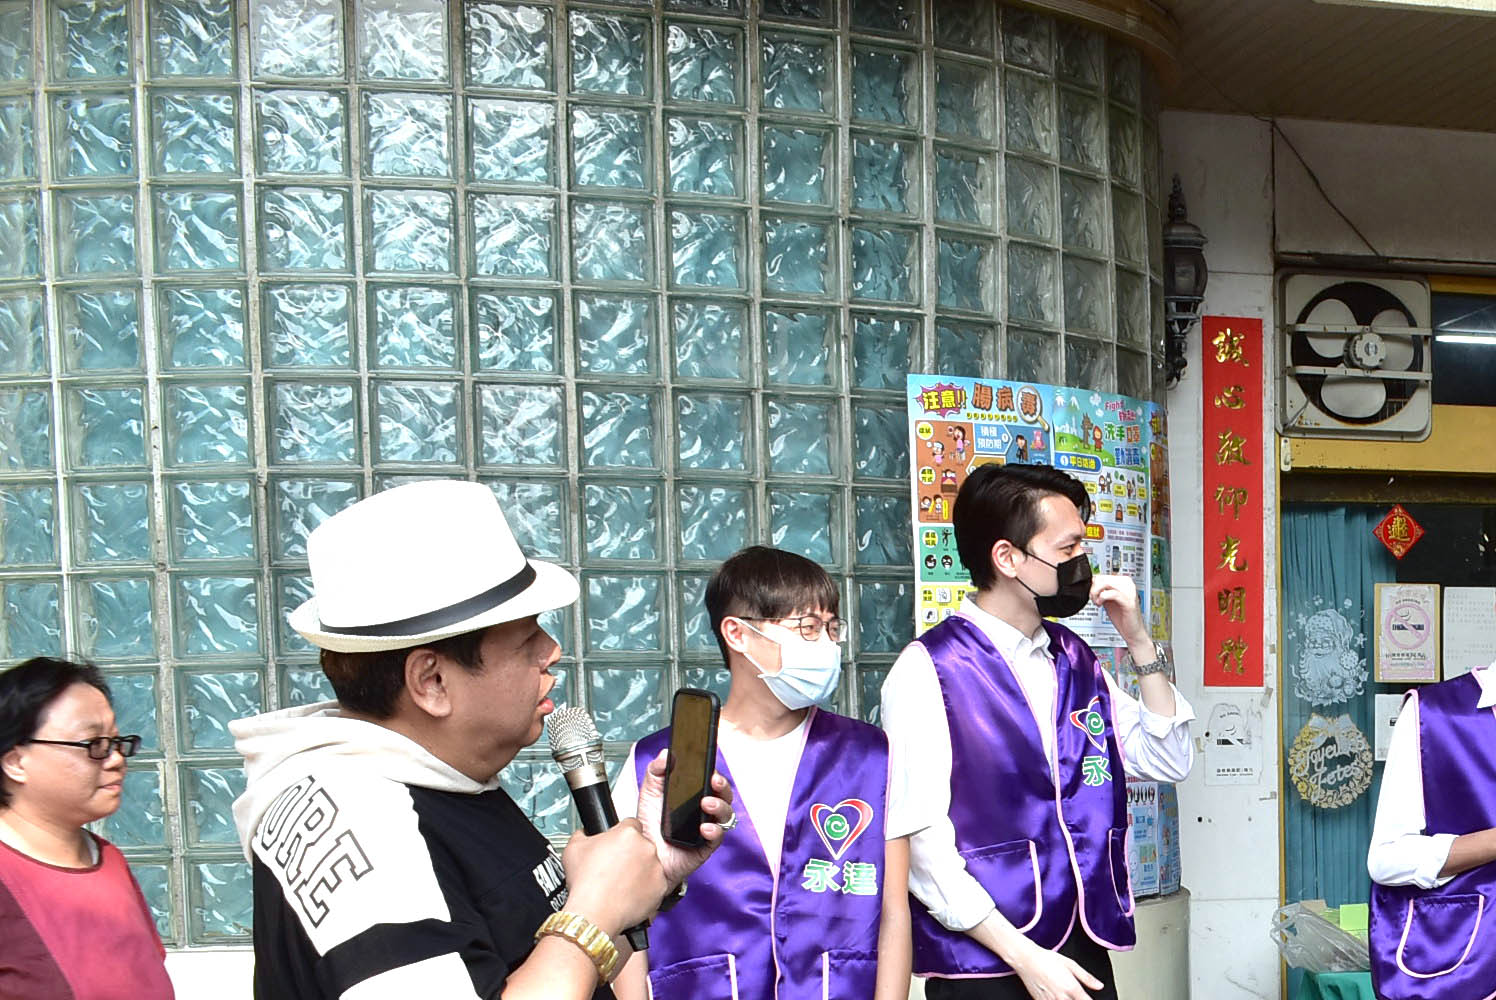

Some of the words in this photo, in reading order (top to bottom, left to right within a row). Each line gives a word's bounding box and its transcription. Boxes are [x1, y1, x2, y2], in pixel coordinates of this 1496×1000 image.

[972, 383, 1038, 417] 腸病毒
[801, 858, 879, 895] 永達
